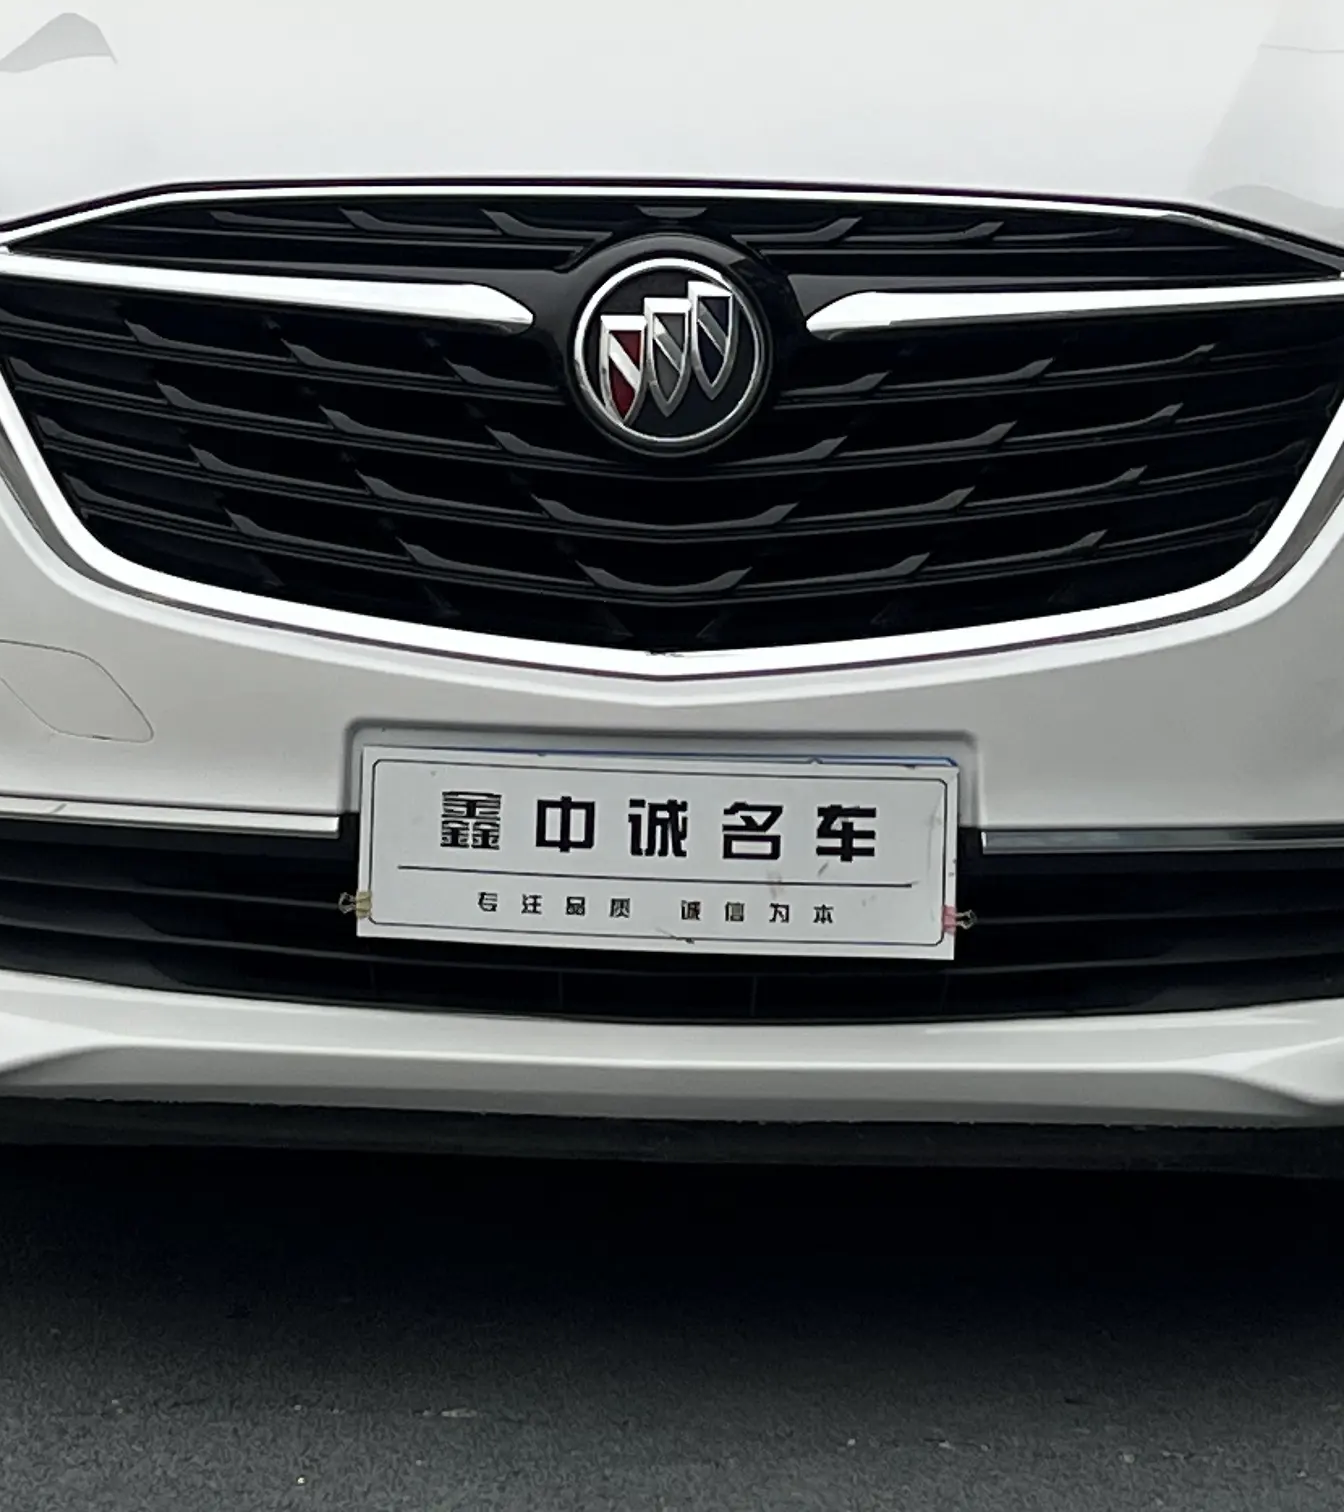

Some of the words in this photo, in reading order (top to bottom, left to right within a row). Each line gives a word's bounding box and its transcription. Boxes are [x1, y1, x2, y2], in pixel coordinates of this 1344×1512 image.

[439, 790, 878, 863] 鑫中诚名车
[477, 891, 632, 919] 专注品质
[680, 899, 835, 926] 诚信为本
